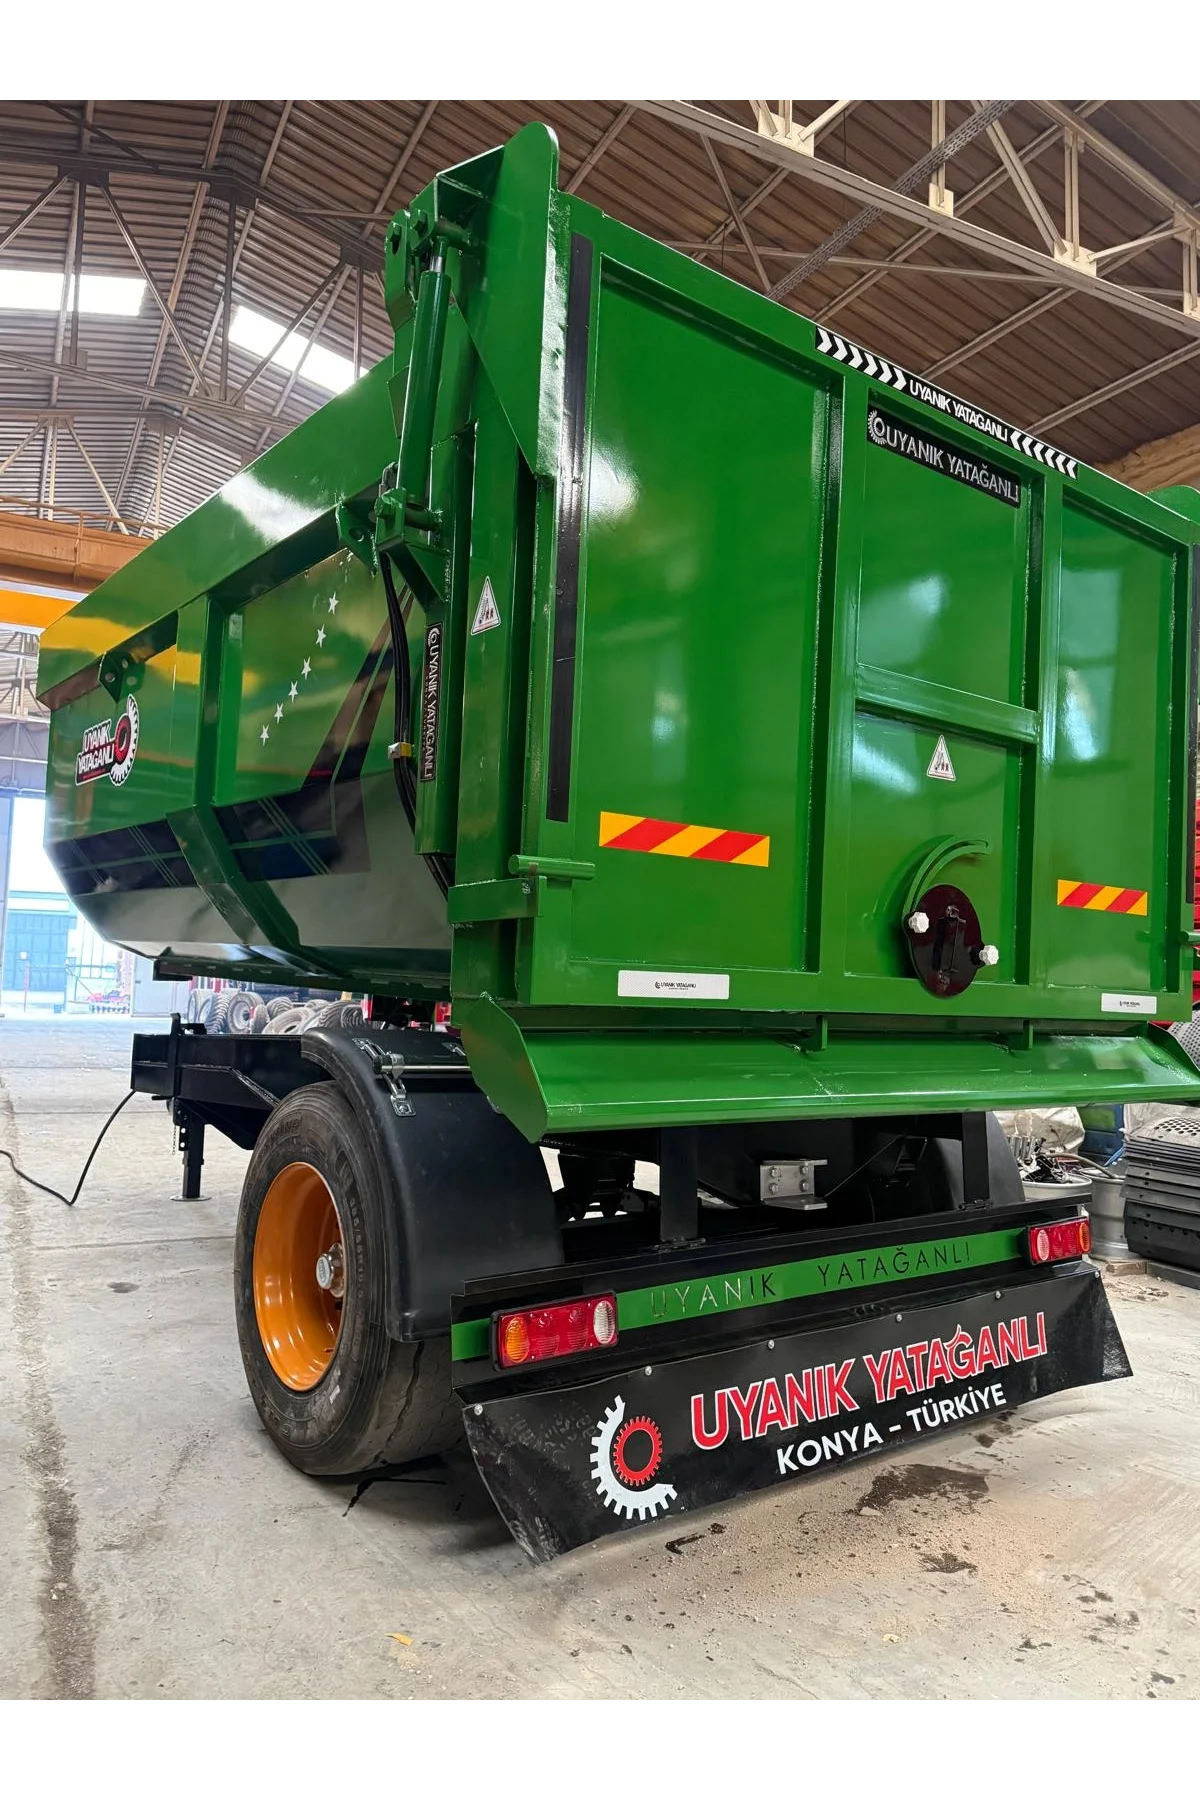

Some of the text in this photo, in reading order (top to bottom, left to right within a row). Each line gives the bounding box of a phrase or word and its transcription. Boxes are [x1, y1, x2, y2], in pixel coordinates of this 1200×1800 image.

[910, 379, 951, 413] UYANIK
[886, 425, 1019, 503] UYANIK YATAĞANLI
[428, 645, 439, 699] UYANIK
[651, 1240, 970, 1318] UYANIK YATAĞANLI
[691, 1311, 1048, 1450] UYANIK YATAĞANLI
[776, 1422, 884, 1475] KONYA
[906, 1383, 1007, 1432] TÜRKİYE
